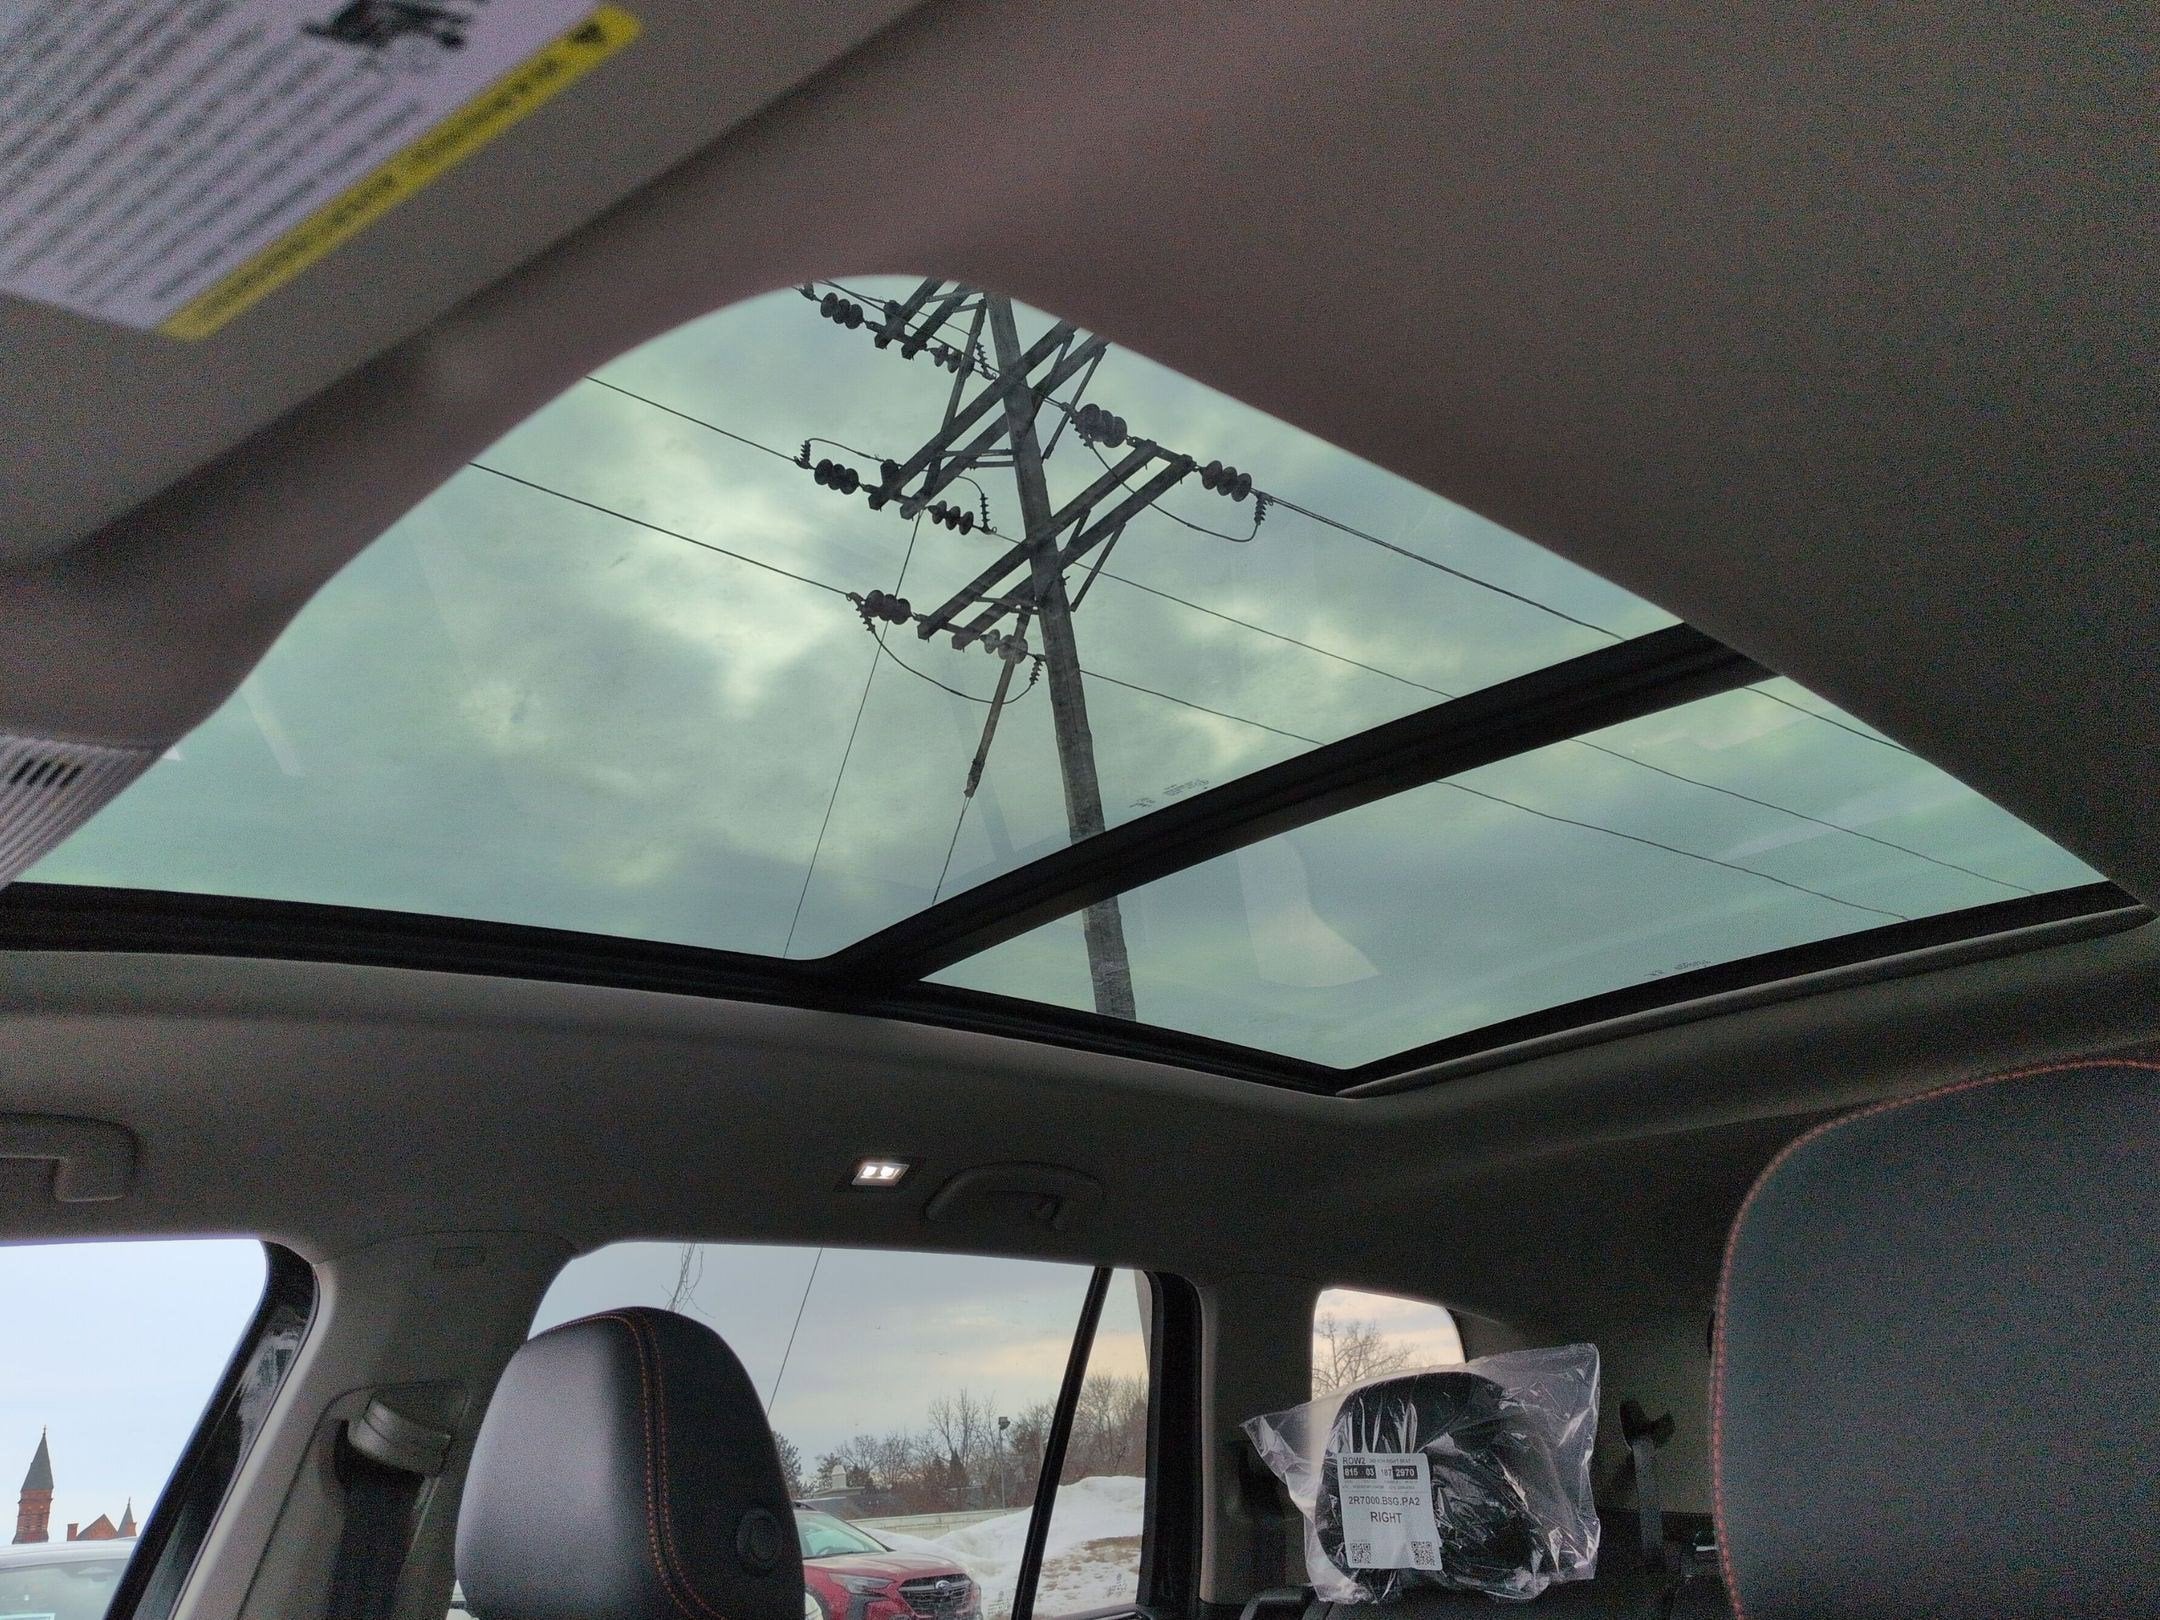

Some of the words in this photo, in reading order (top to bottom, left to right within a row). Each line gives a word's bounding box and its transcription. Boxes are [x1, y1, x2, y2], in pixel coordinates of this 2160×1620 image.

[1342, 1457, 1366, 1465] ROW2
[1344, 1468, 1358, 1476] 815
[1365, 1468, 1375, 1476] 03
[1395, 1468, 1415, 1477] 2970
[1370, 1511, 1402, 1523] RIGHT
